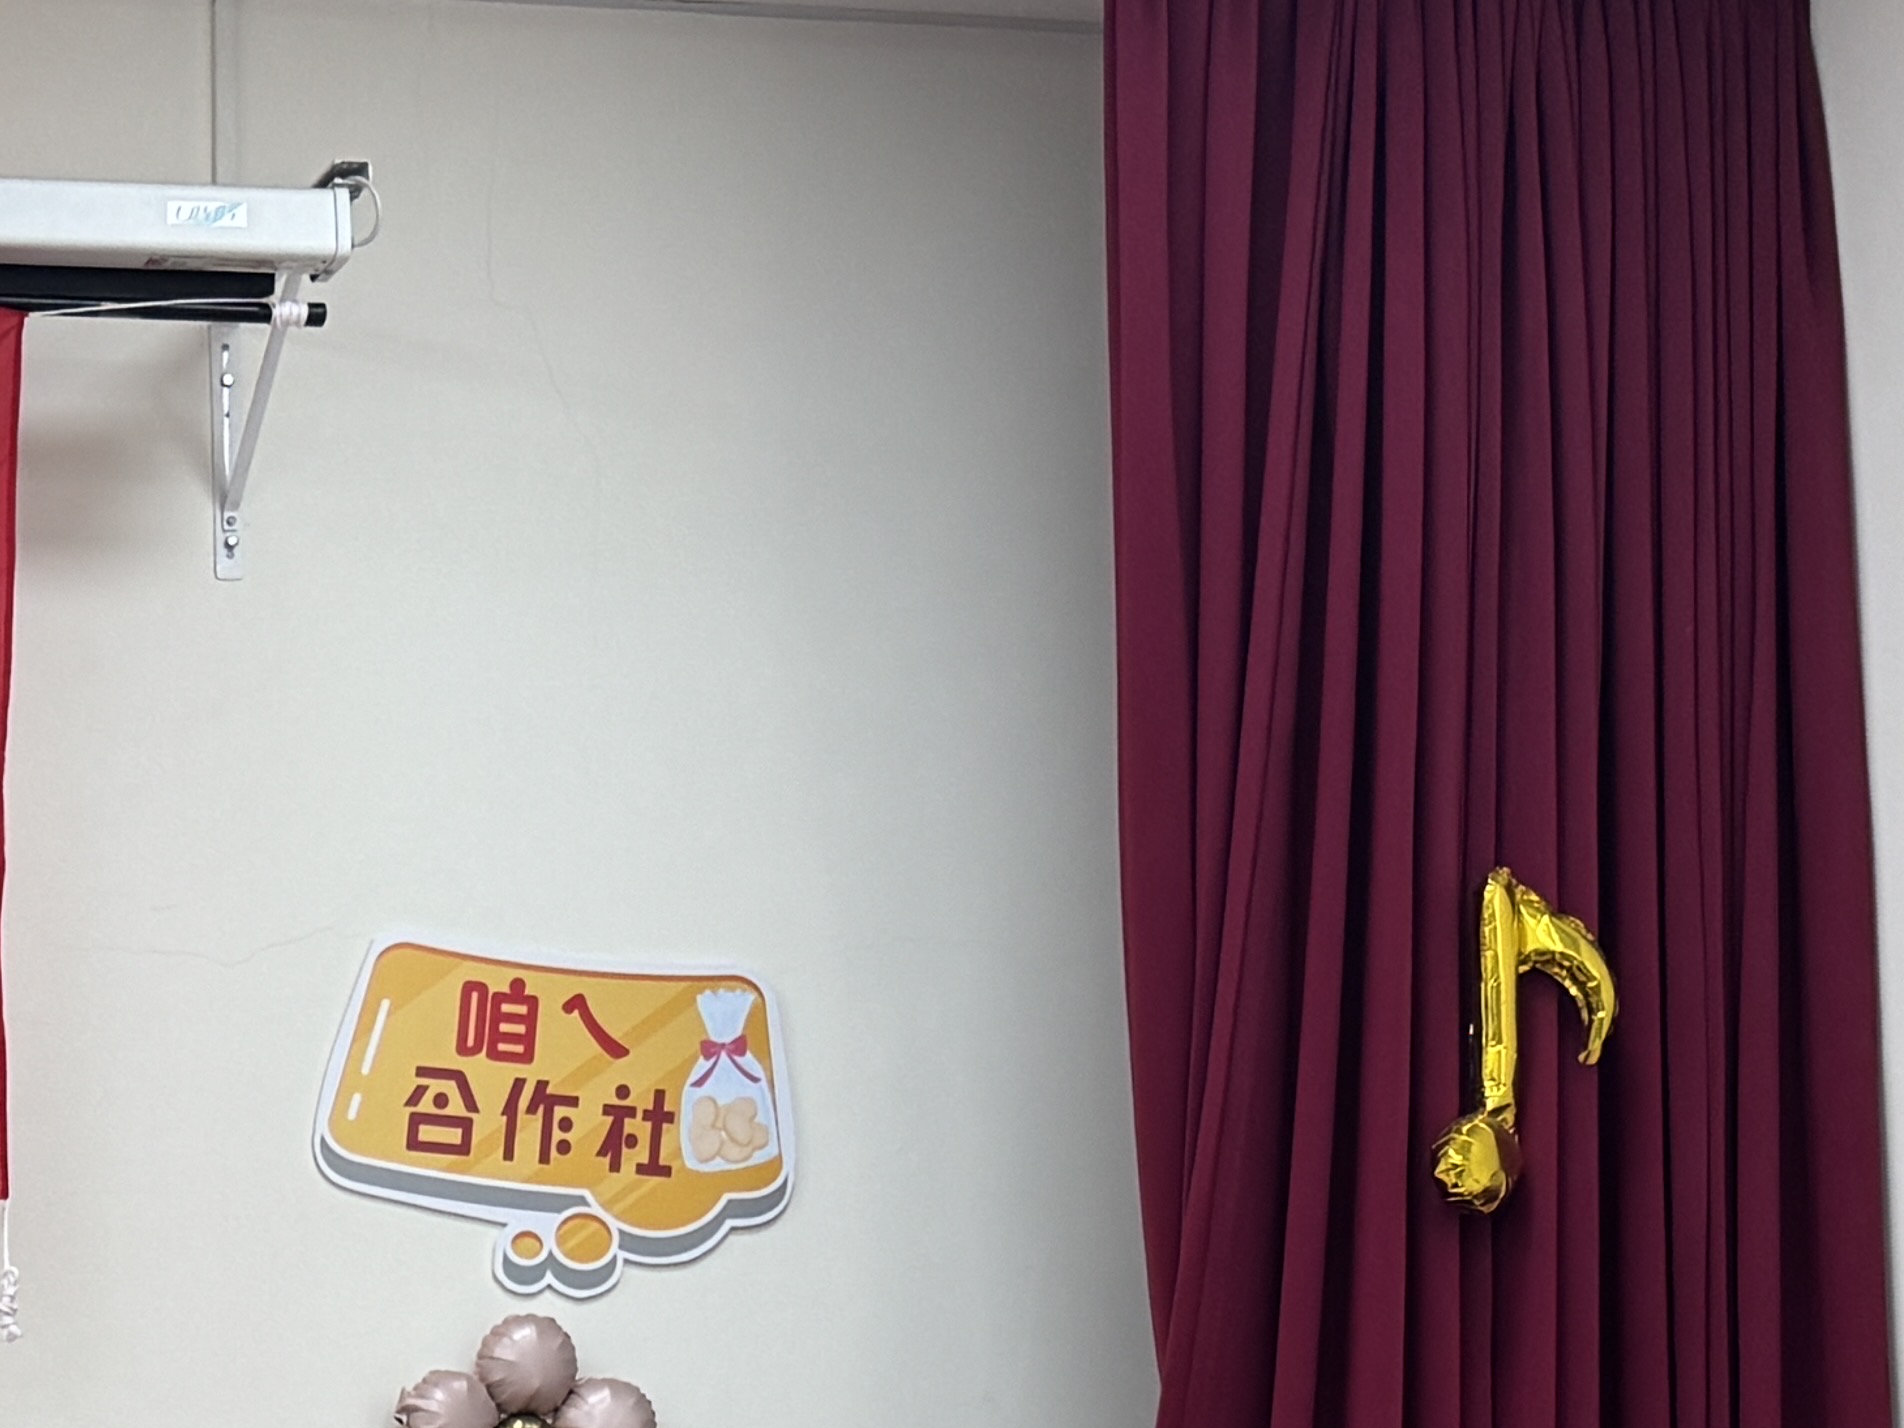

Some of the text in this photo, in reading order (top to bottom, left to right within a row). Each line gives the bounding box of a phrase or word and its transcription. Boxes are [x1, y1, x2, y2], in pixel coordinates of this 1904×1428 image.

[455, 977, 631, 1065] 咱入
[403, 1065, 676, 1178] 合作社
